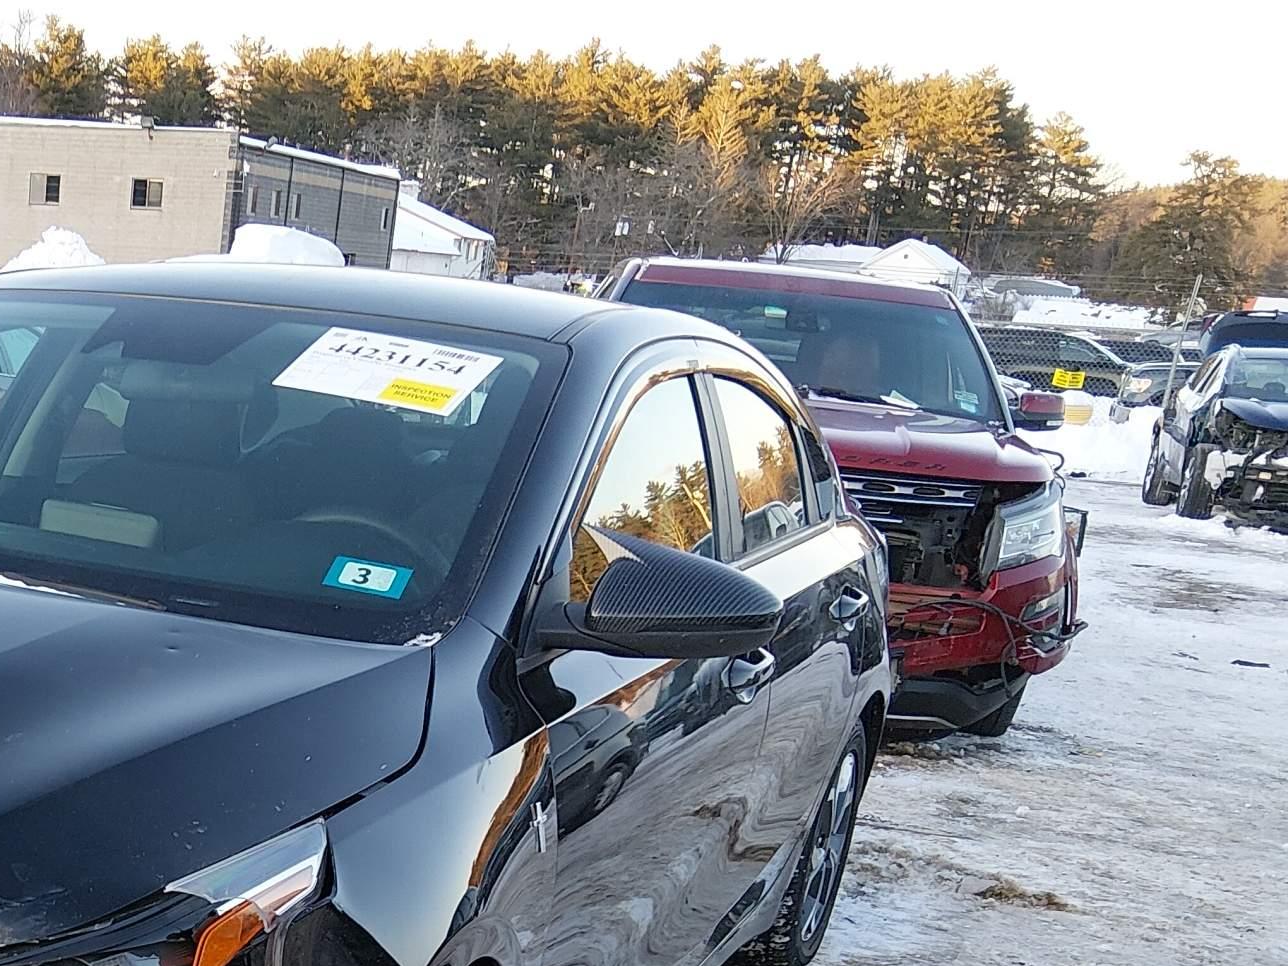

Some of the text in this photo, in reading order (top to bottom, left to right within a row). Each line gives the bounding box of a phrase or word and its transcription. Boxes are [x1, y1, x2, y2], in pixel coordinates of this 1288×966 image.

[329, 343, 467, 375] 44231154
[391, 383, 452, 399] INSPECTION
[393, 390, 439, 402] SERVICE
[351, 567, 372, 585] 3
